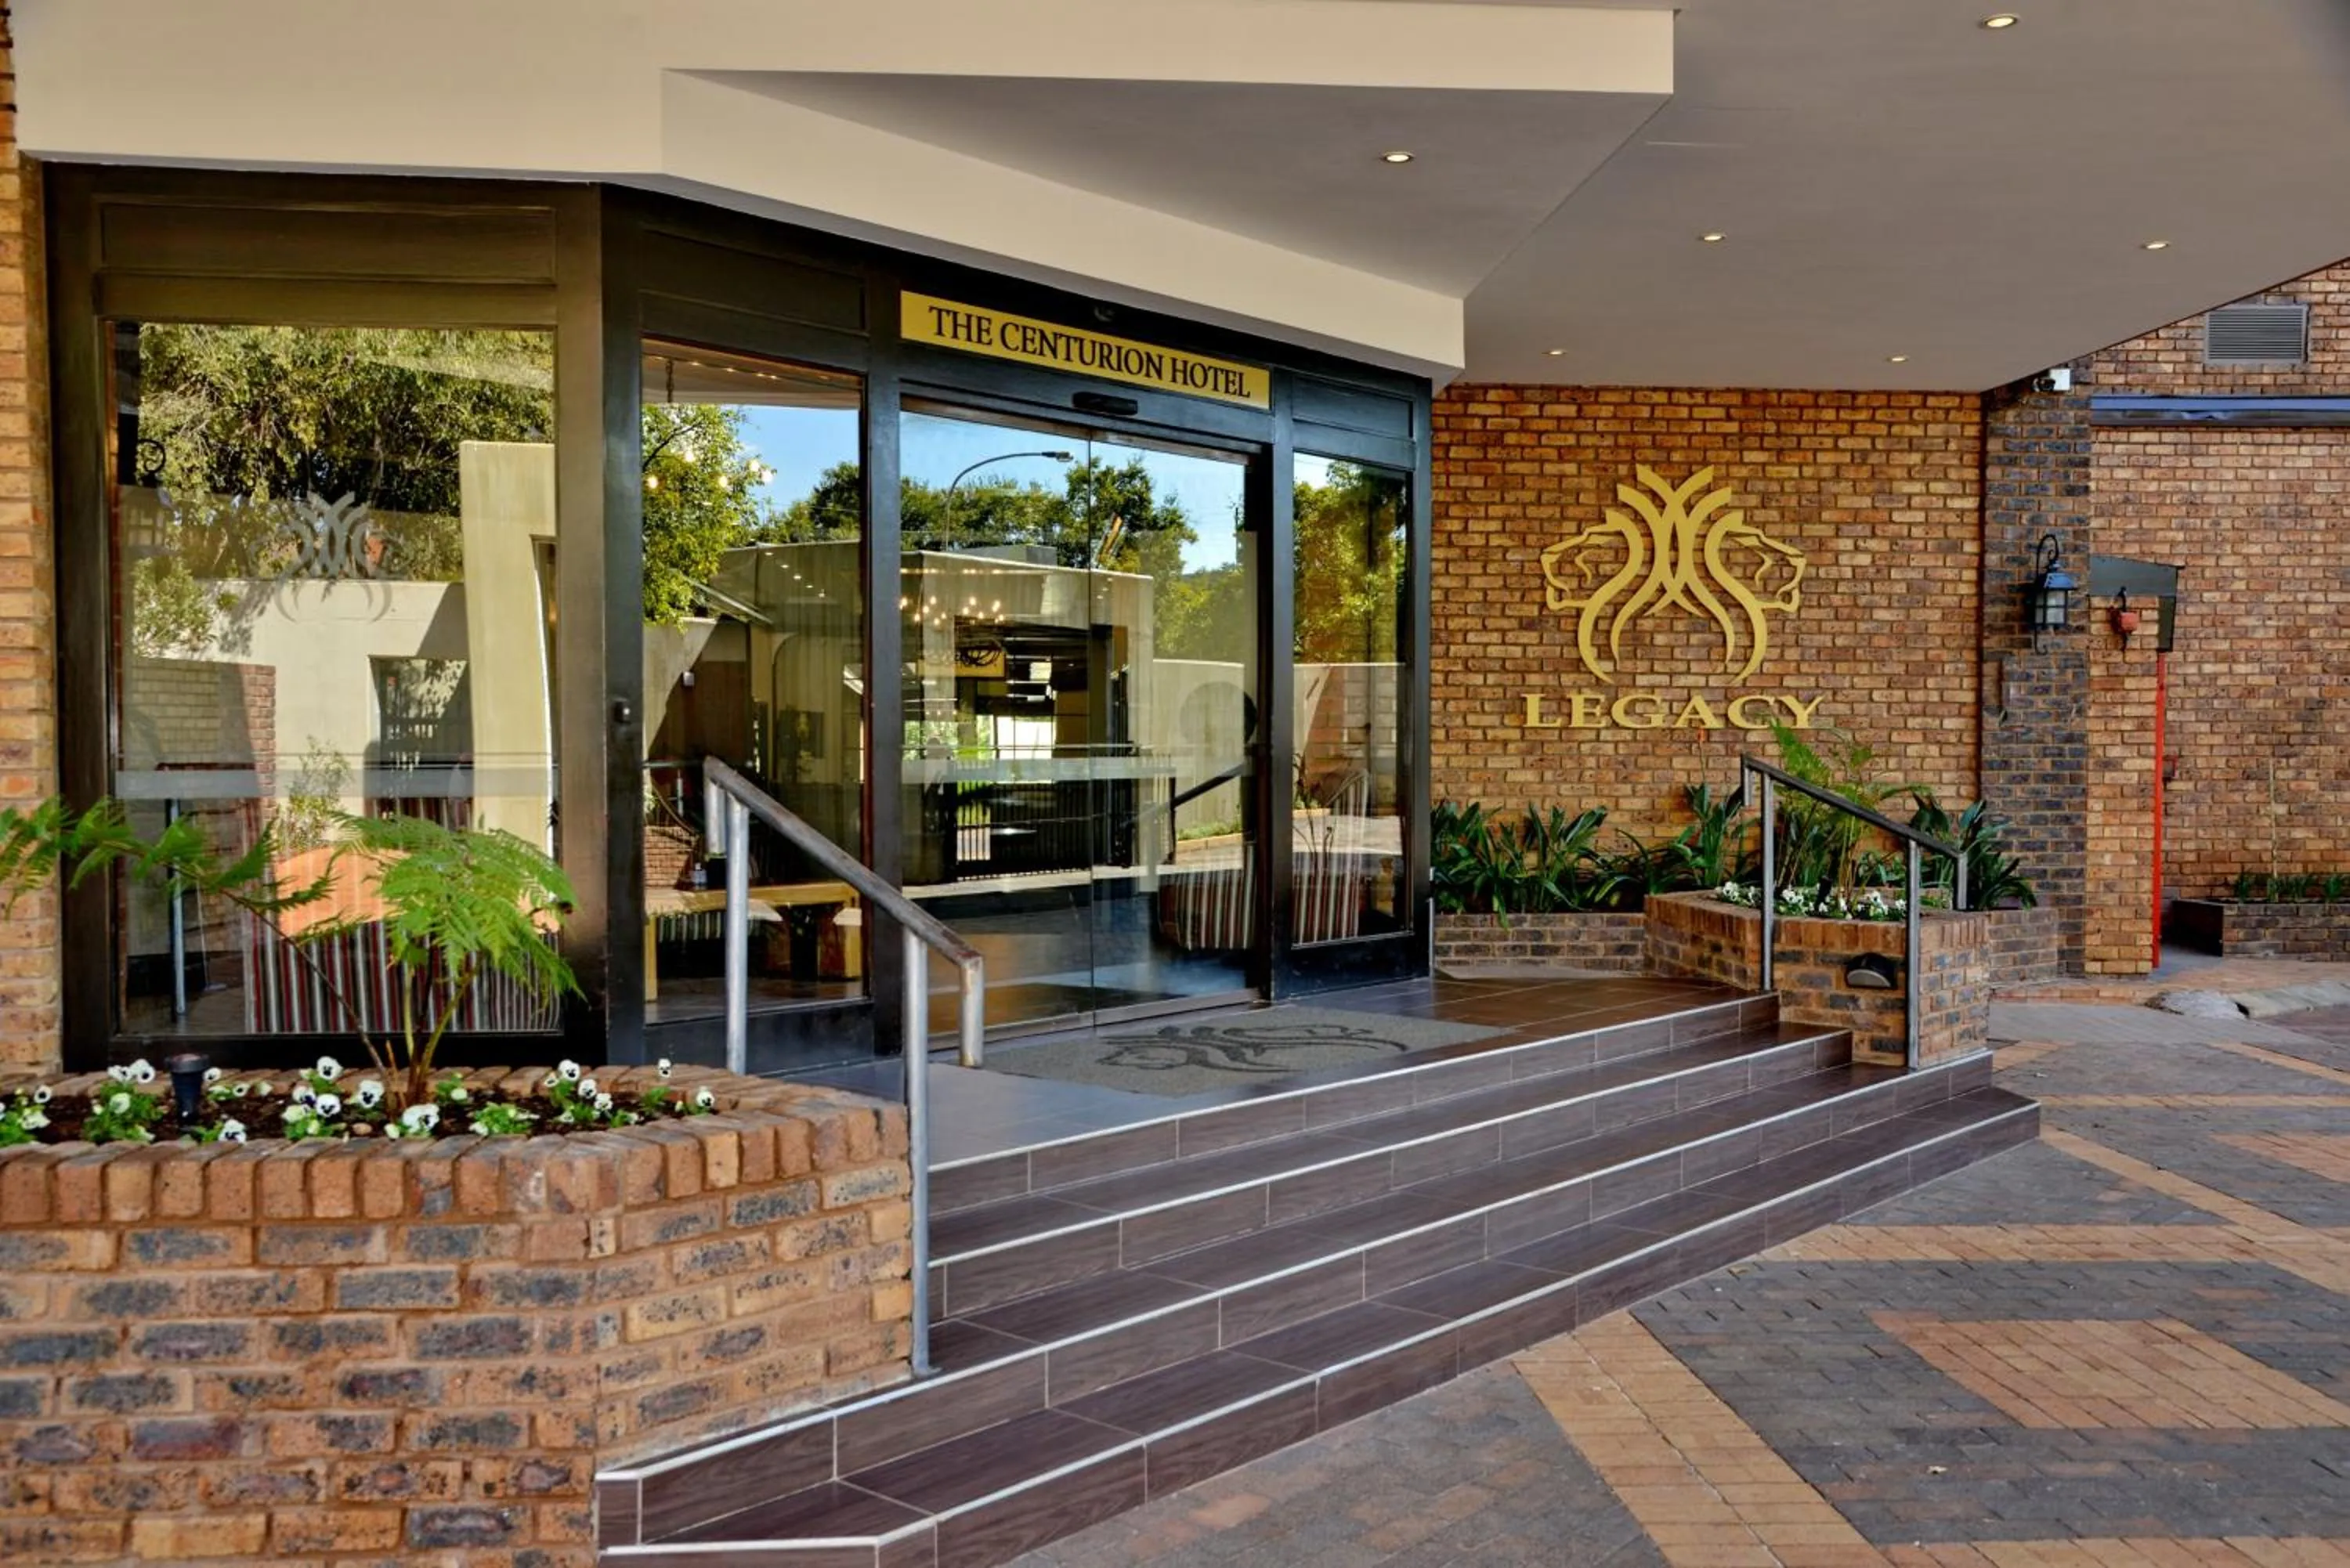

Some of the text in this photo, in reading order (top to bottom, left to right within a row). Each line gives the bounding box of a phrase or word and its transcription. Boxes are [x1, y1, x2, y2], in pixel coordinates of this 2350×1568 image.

[930, 306, 1252, 399] THE CENTURION HOTEL
[1521, 693, 1826, 729] LEGACY
